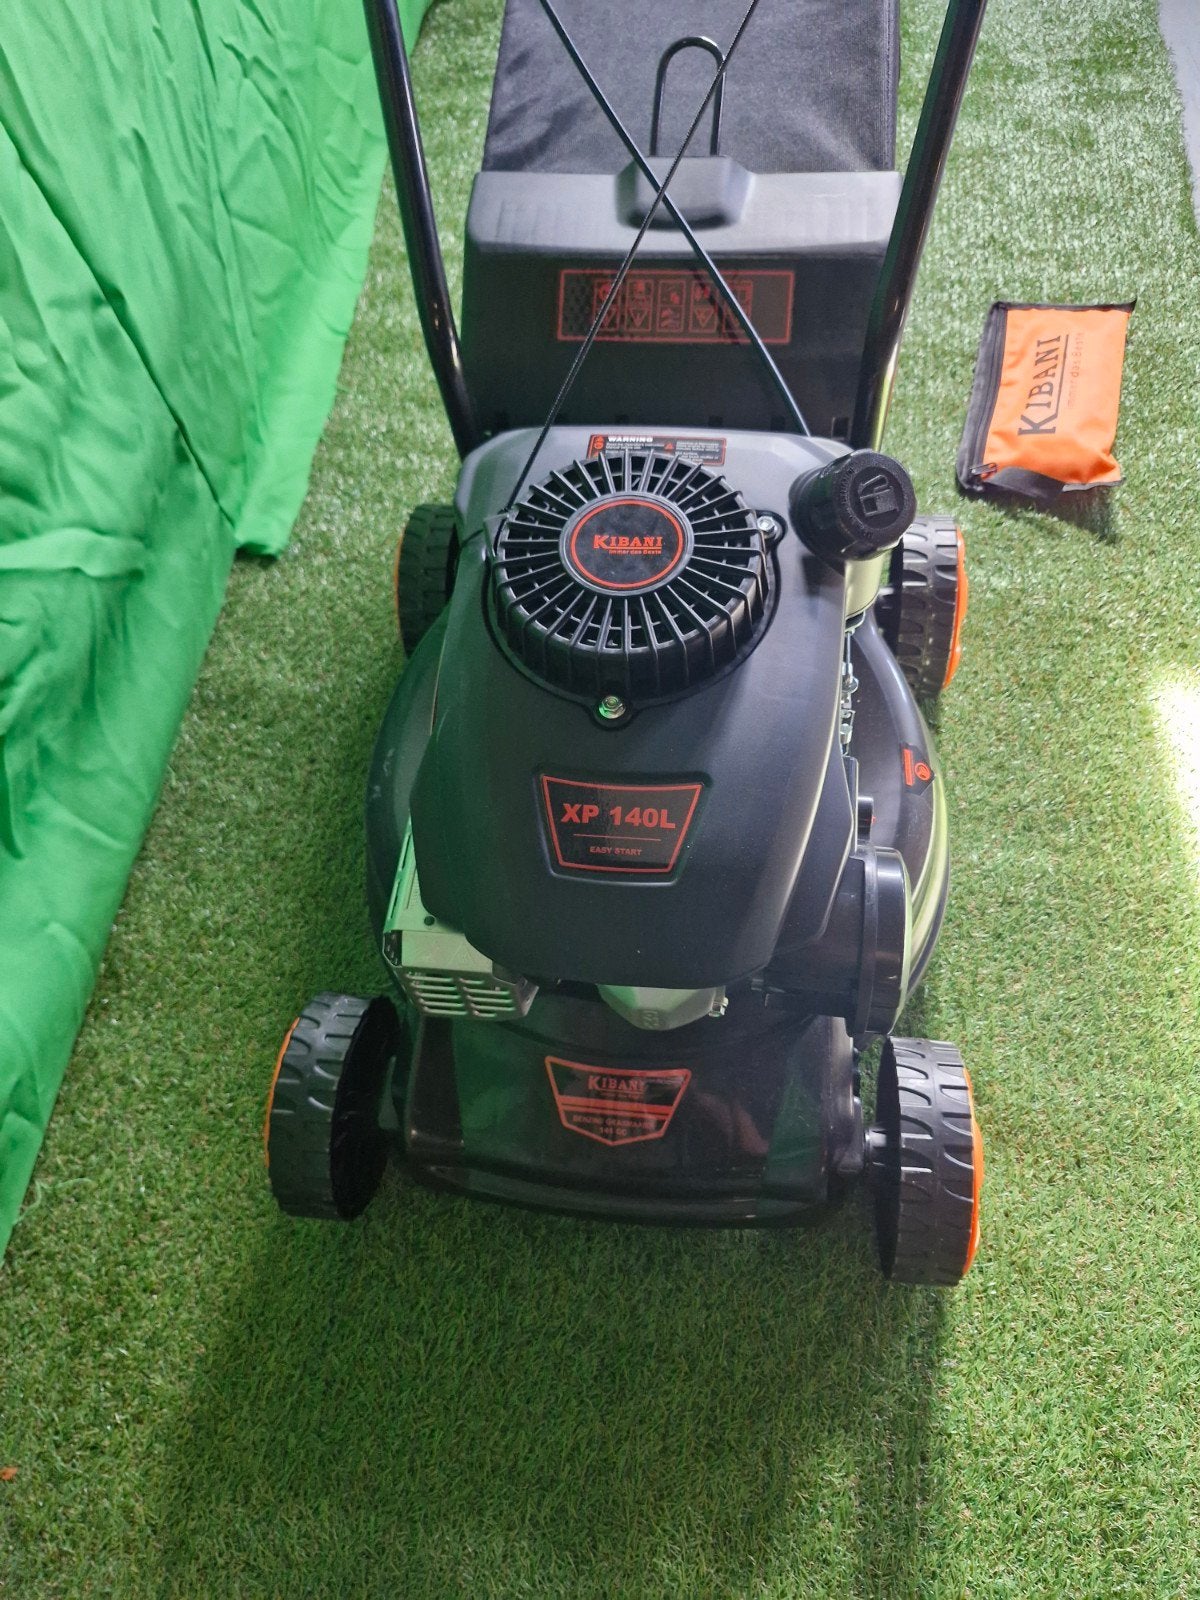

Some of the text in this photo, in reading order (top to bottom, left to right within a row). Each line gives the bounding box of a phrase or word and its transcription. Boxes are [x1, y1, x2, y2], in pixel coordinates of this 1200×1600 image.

[1018, 335, 1061, 436] KIBANI
[593, 535, 663, 549] KIBANI
[561, 803, 676, 829] XP 140L
[589, 845, 643, 857] EASY START
